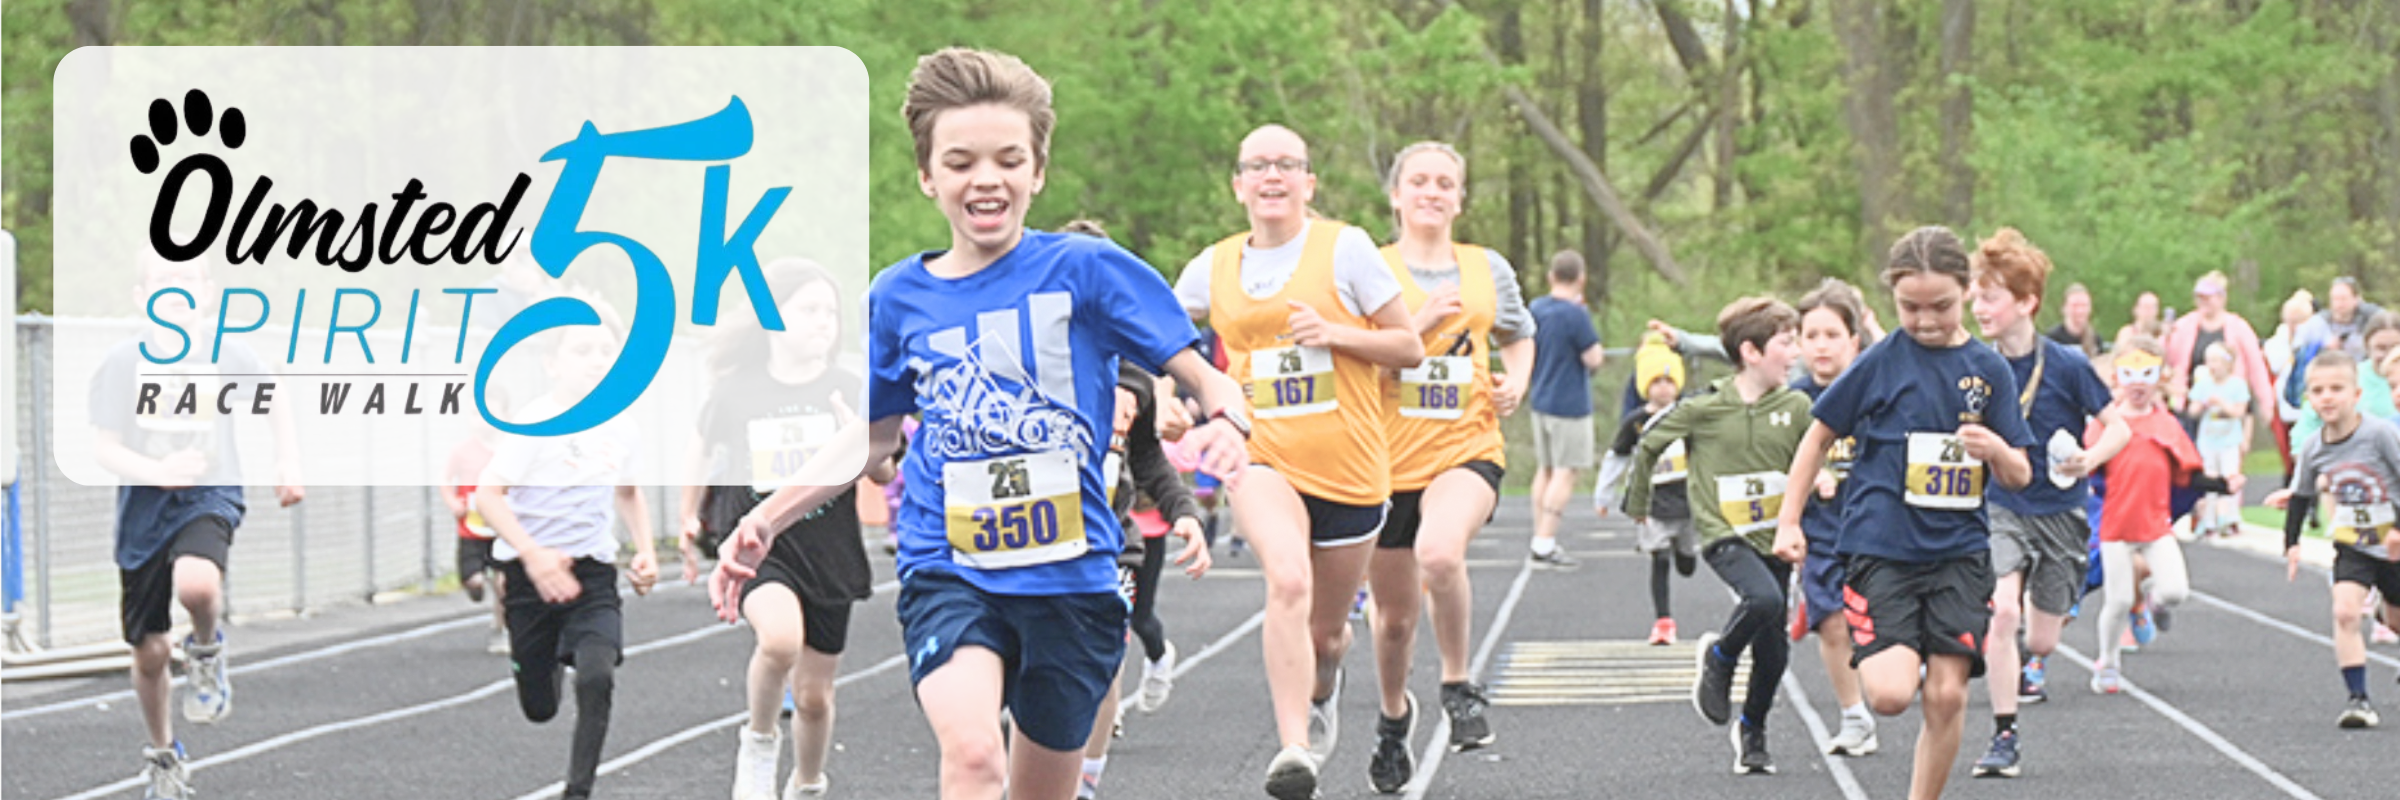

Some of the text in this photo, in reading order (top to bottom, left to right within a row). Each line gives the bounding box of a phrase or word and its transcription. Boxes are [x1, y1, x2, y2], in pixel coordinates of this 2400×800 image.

[1271, 376, 1314, 406] 167
[1417, 384, 1459, 409] 168
[1926, 466, 1972, 496] 316
[971, 499, 1059, 551] 350
